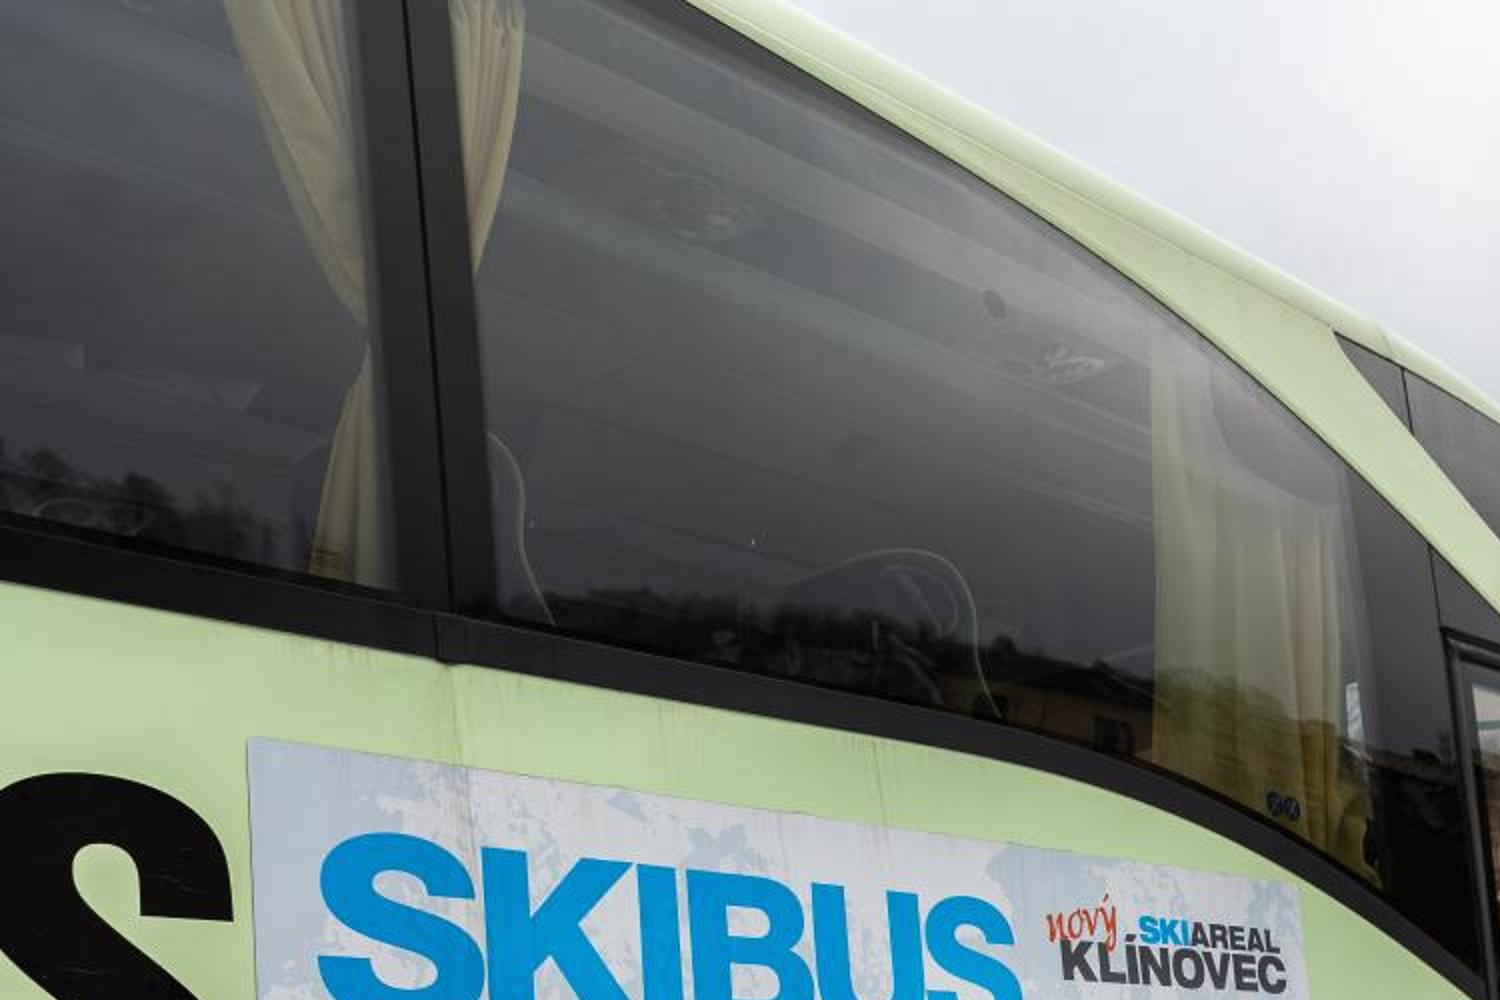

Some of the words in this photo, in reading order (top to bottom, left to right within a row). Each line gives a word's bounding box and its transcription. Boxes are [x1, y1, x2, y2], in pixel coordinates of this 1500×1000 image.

[1046, 893, 1118, 952] nový
[1138, 915, 1281, 955] SKIAREAL
[1060, 934, 1288, 995] KLÍNOVEC
